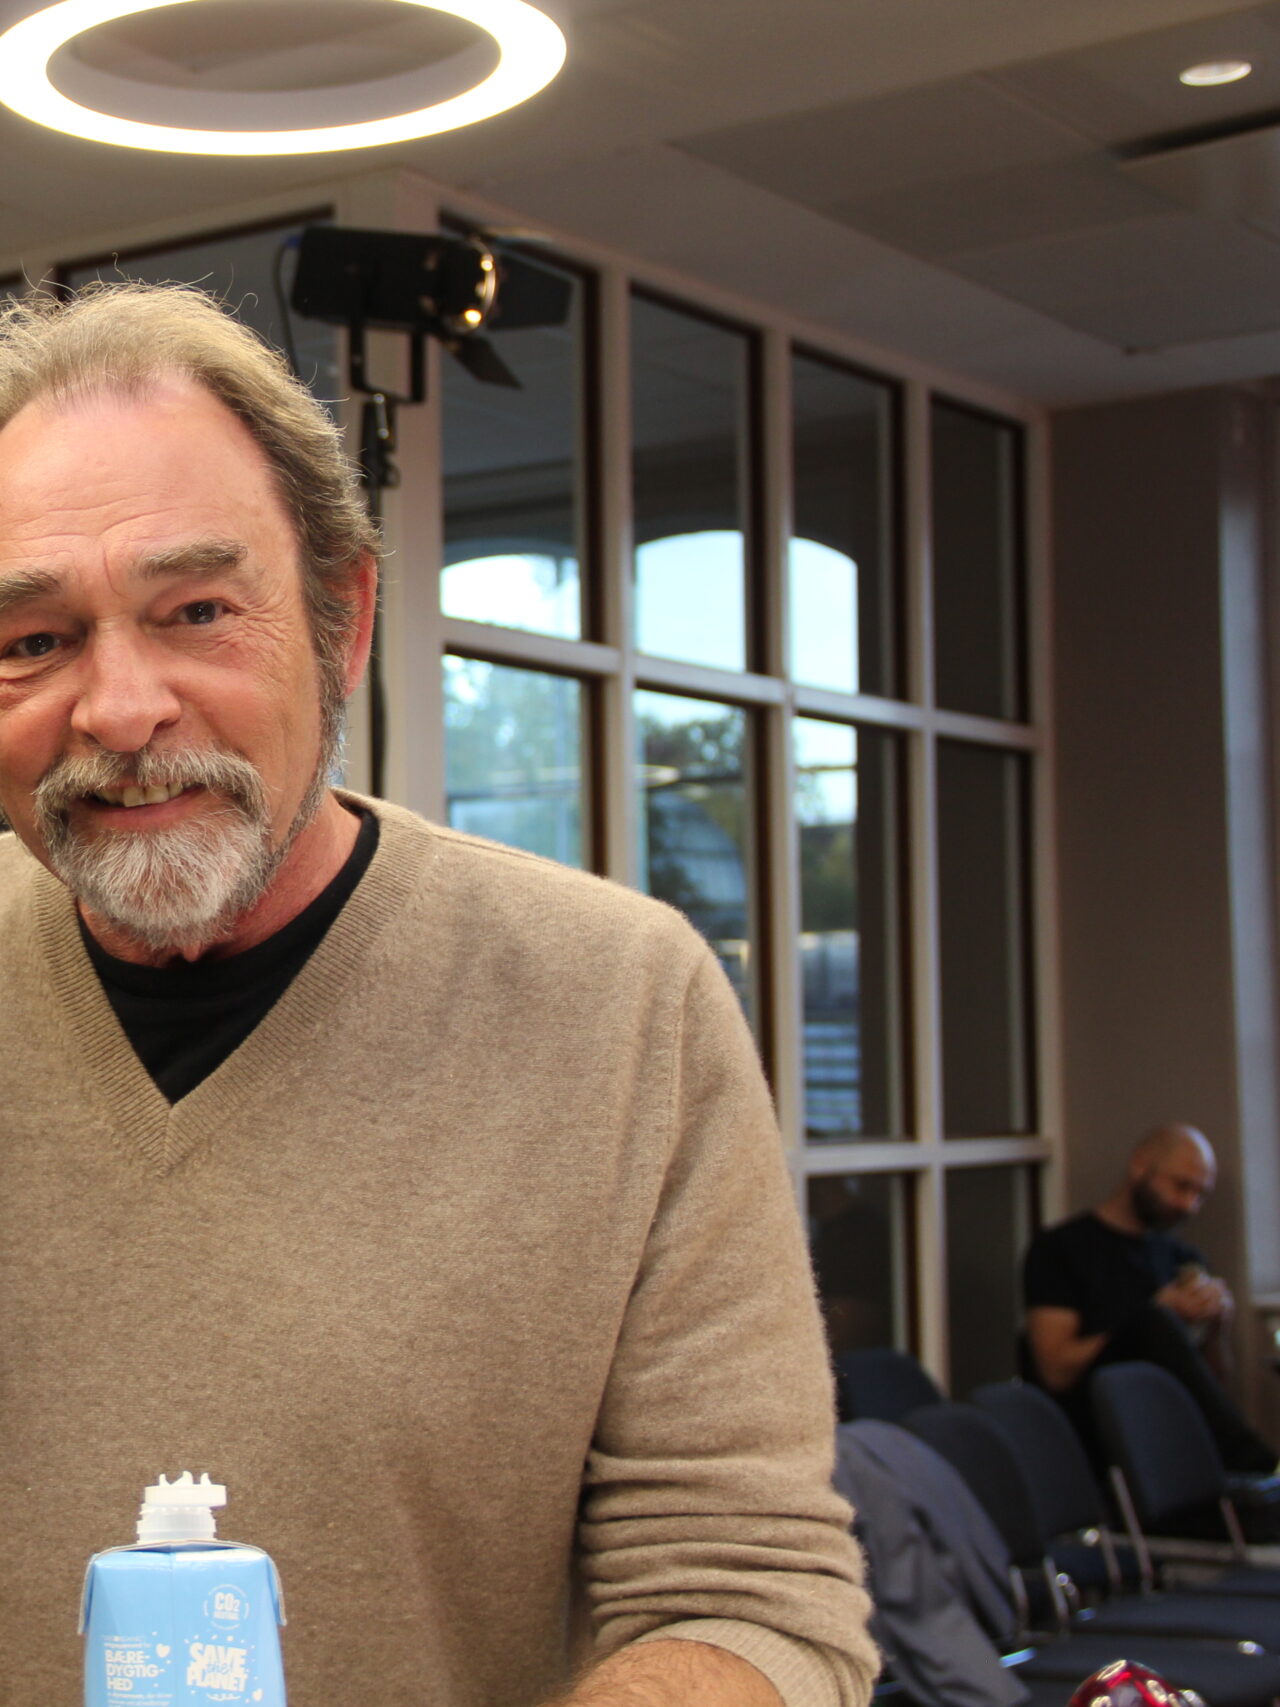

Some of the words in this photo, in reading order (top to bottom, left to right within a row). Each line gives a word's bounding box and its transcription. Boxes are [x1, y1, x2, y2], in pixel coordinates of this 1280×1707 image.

[105, 1650, 150, 1664] BÆRE-
[189, 1642, 247, 1673] SAVE
[106, 1663, 165, 1678] DYGTIG-
[186, 1661, 248, 1691] PLANET
[107, 1677, 133, 1691] HED
